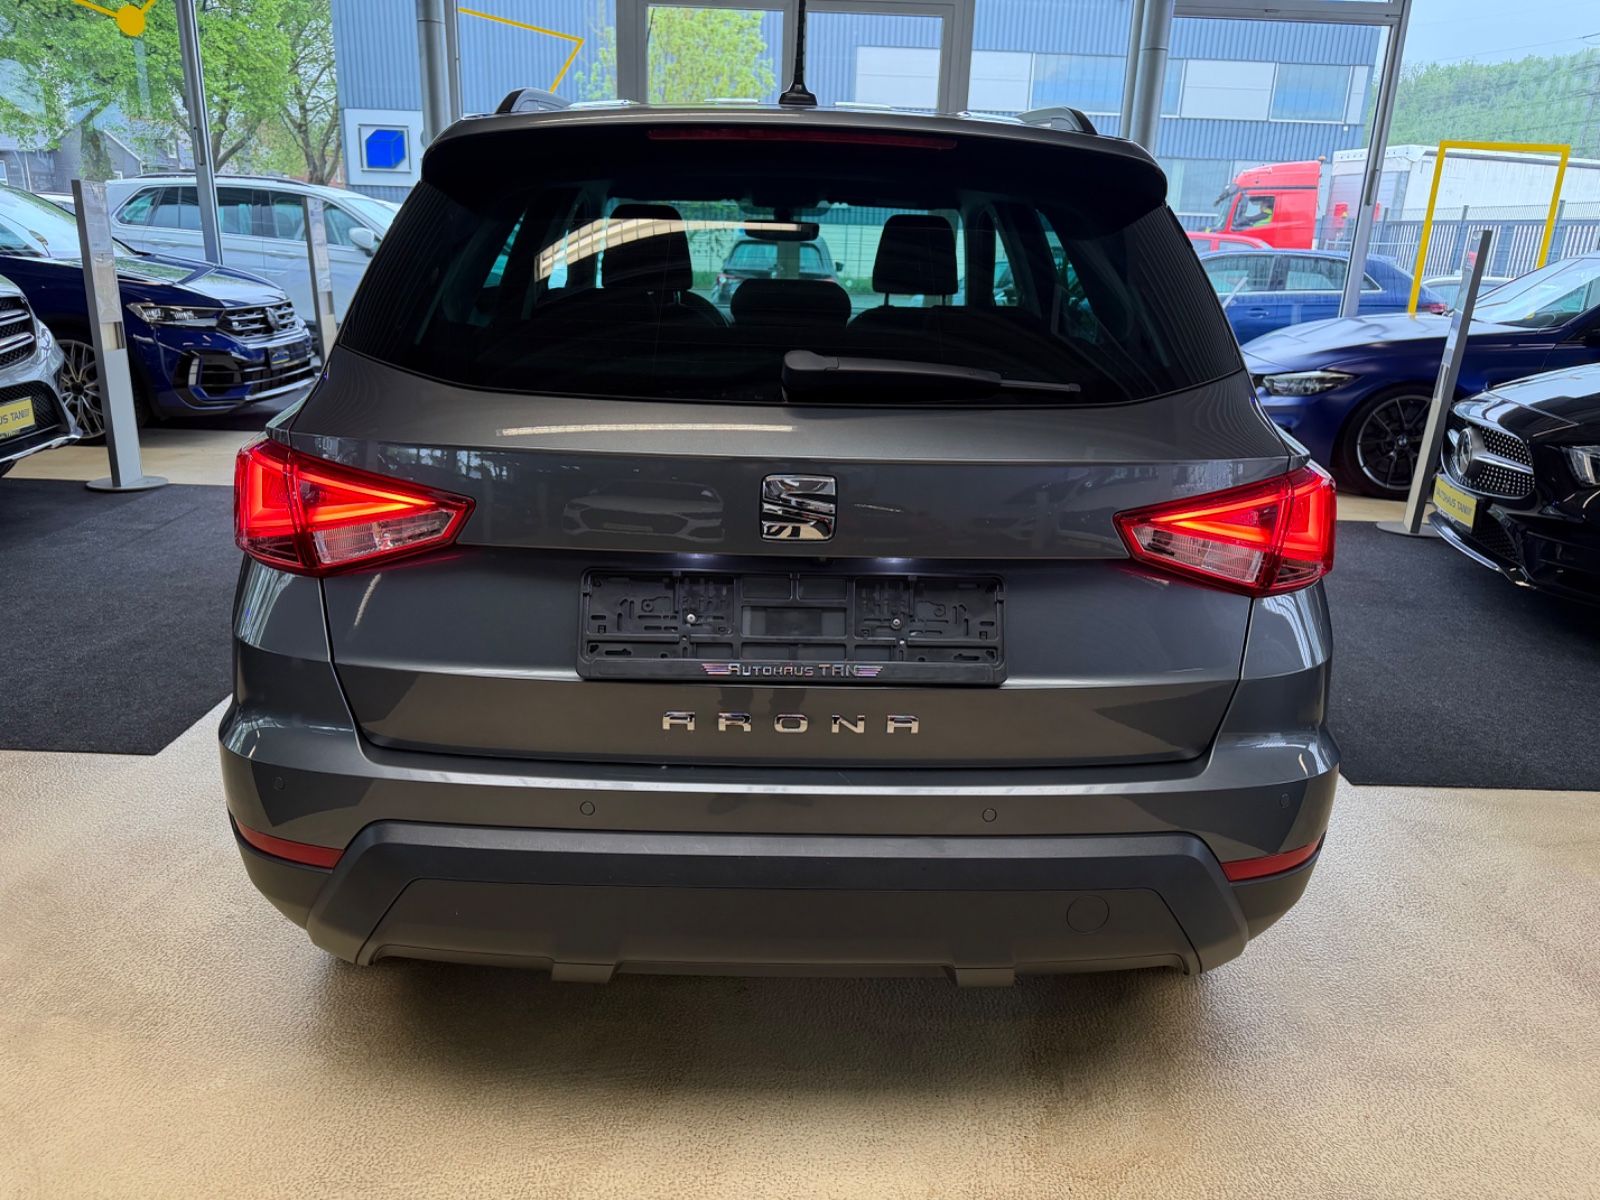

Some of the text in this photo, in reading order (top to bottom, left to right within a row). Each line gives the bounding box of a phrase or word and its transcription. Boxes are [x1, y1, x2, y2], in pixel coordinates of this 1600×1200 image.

[728, 663, 859, 677] AUTOHAUS TAN
[662, 711, 920, 734] ARONA
